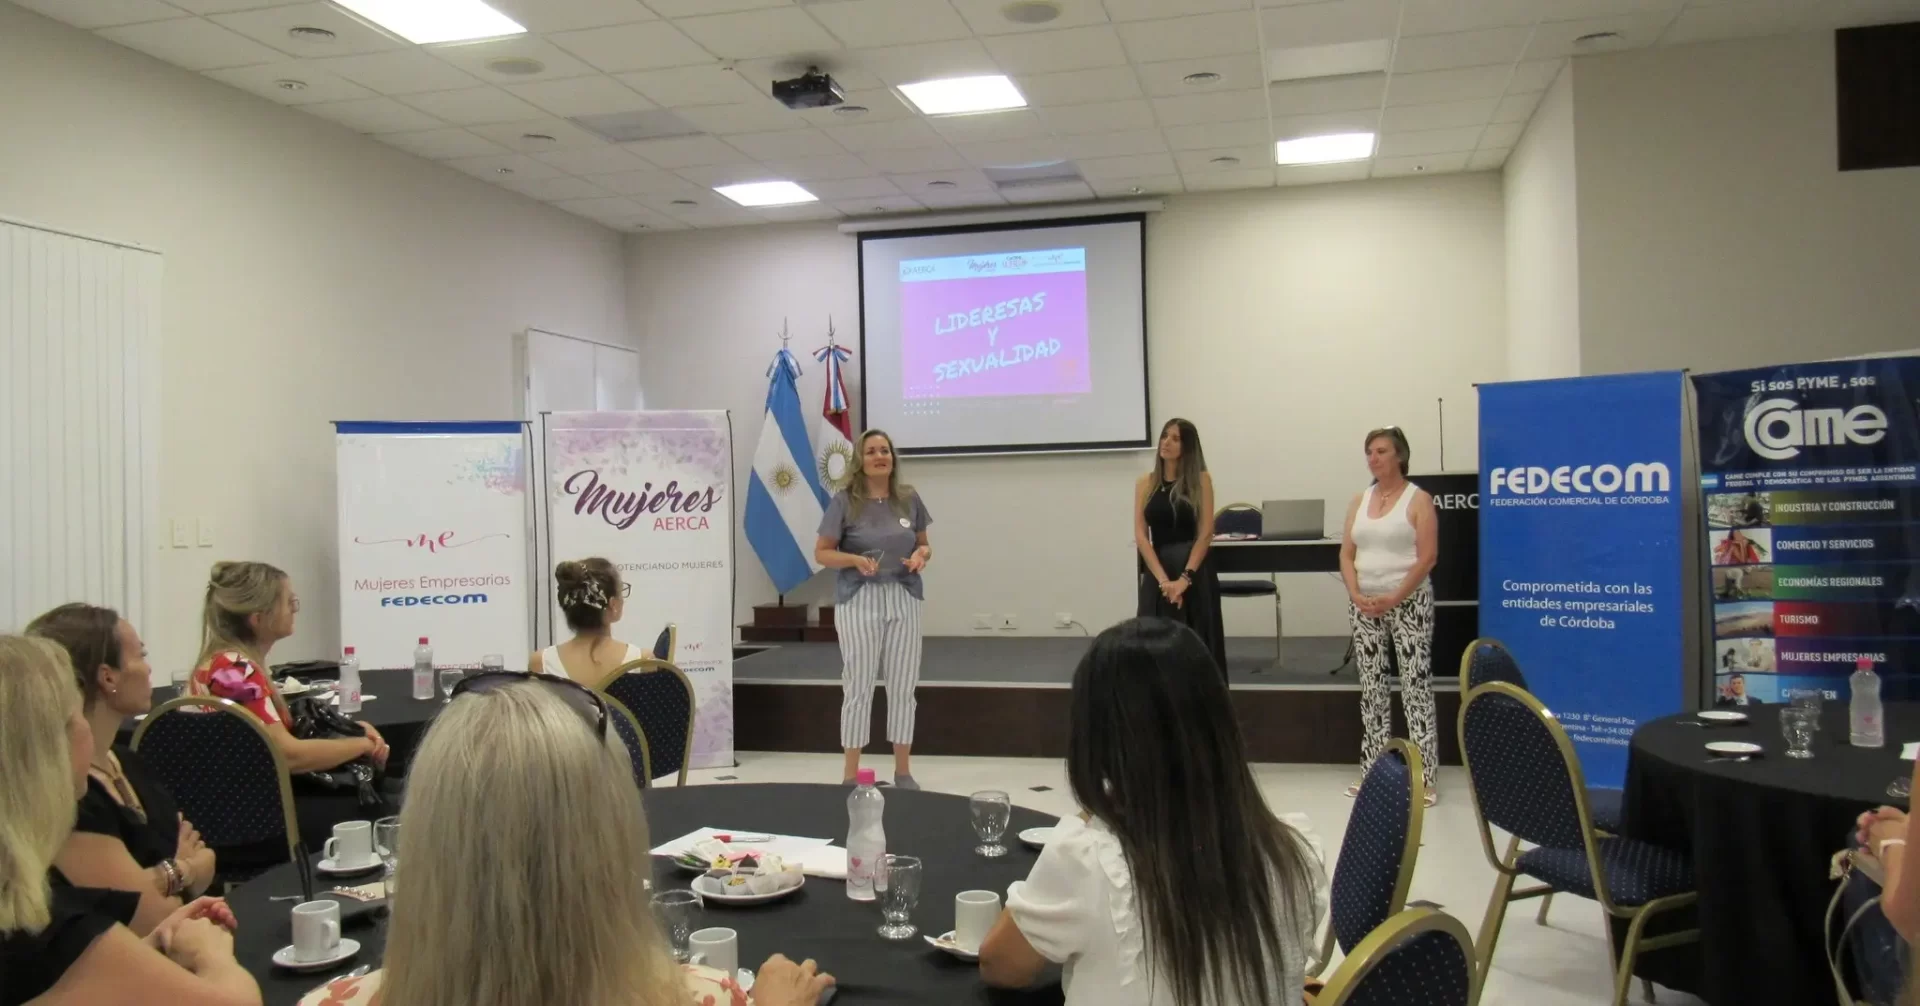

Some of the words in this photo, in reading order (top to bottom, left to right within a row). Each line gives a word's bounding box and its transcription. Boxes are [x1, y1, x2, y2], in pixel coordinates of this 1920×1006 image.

[934, 291, 1047, 335] LIDERESAS
[987, 326, 999, 347] Y
[932, 337, 1061, 382] SEXUALIDAD
[1751, 379, 1766, 393] Si
[1768, 380, 1794, 391] sos
[1797, 376, 1840, 390] PYME
[1850, 376, 1876, 387] sos
[1490, 462, 1670, 495] FEDECOM
[1725, 472, 1744, 480] CAME
[1745, 471, 1771, 479] CUMPLE
[1800, 469, 1844, 477] COMPROMISO
[1857, 467, 1872, 475] SER
[1884, 466, 1916, 474] ENTIDAD
[1725, 479, 1754, 487] FEDERAL
[1871, 473, 1916, 481] ARGENTINAS
[563, 469, 722, 530] Mujeres
[1433, 494, 1479, 510] AERC
[1490, 496, 1546, 507] FEDERACIÓN
[1549, 495, 1605, 506] COMERCIAL
[1605, 496, 1618, 505] DE
[1620, 494, 1670, 505] CÓRDOBA
[1775, 503, 1820, 513] INDUSTRIA
[1821, 502, 1828, 512] Y
[1829, 499, 1895, 512] CONSTRUCCIÓN
[653, 516, 710, 531] AERCA
[1776, 540, 1820, 550] COMERCIO
[1821, 540, 1828, 549] Y
[1829, 539, 1874, 549] SERVICIOS
[615, 561, 680, 572] OTENCIANDO
[681, 560, 724, 570] MUJERES
[354, 577, 415, 592] Mujeres
[419, 574, 511, 590] Empresarias
[1502, 579, 1601, 597] Comprometida
[1604, 585, 1630, 594] con
[1633, 583, 1653, 595] las
[1778, 575, 1828, 587] ECONOMÍAS
[1829, 577, 1883, 587] REGIONALES
[381, 593, 488, 607] FEDECOM
[1502, 597, 1562, 610] entidades
[1564, 600, 1654, 614] empresariales
[1539, 615, 1556, 627] de
[1559, 616, 1615, 629] Córdoba
[1780, 614, 1819, 624] TURISMO
[1781, 652, 1821, 662] MUJERES
[1592, 715, 1621, 724] General
[1622, 717, 1636, 726] Paz
